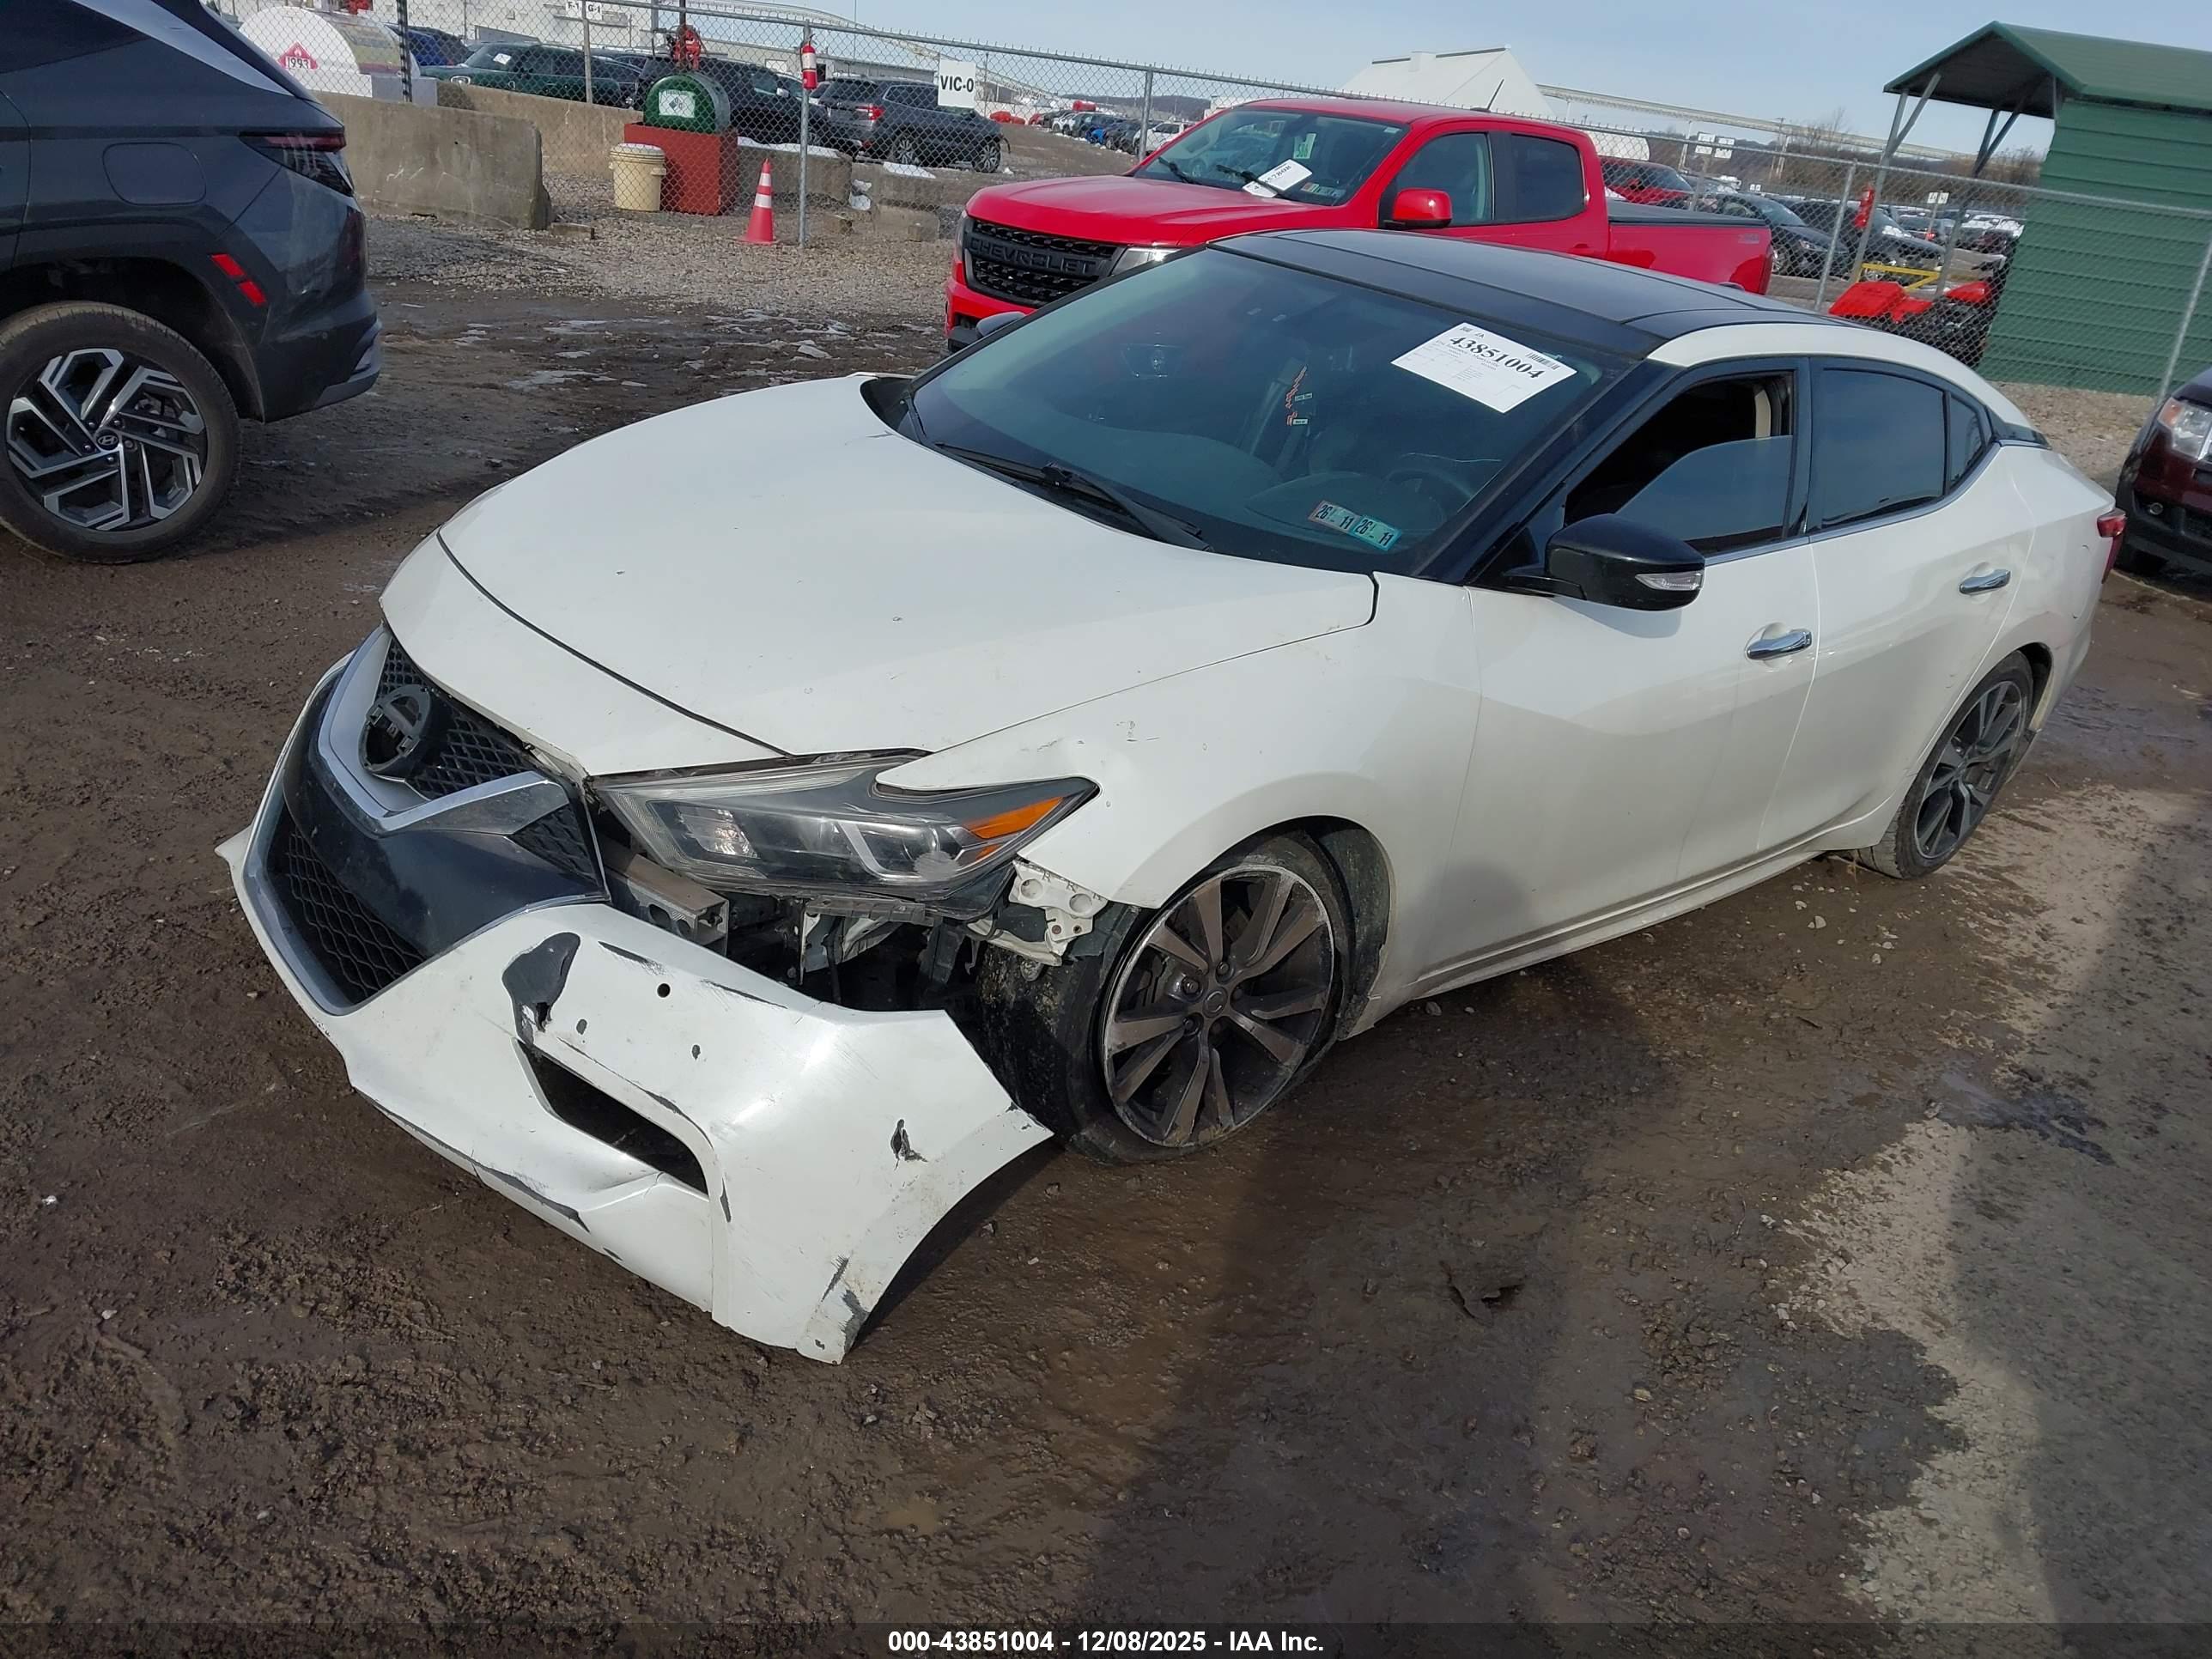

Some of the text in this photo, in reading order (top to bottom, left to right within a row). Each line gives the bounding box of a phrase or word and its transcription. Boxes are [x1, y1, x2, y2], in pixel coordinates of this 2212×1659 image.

[588, 4, 600, 13] G-1
[970, 237, 1096, 275] CHEVROLET
[1450, 337, 1544, 378] 43851004
[1316, 504, 1354, 530] 26 11
[1355, 519, 1394, 546] 26 11
